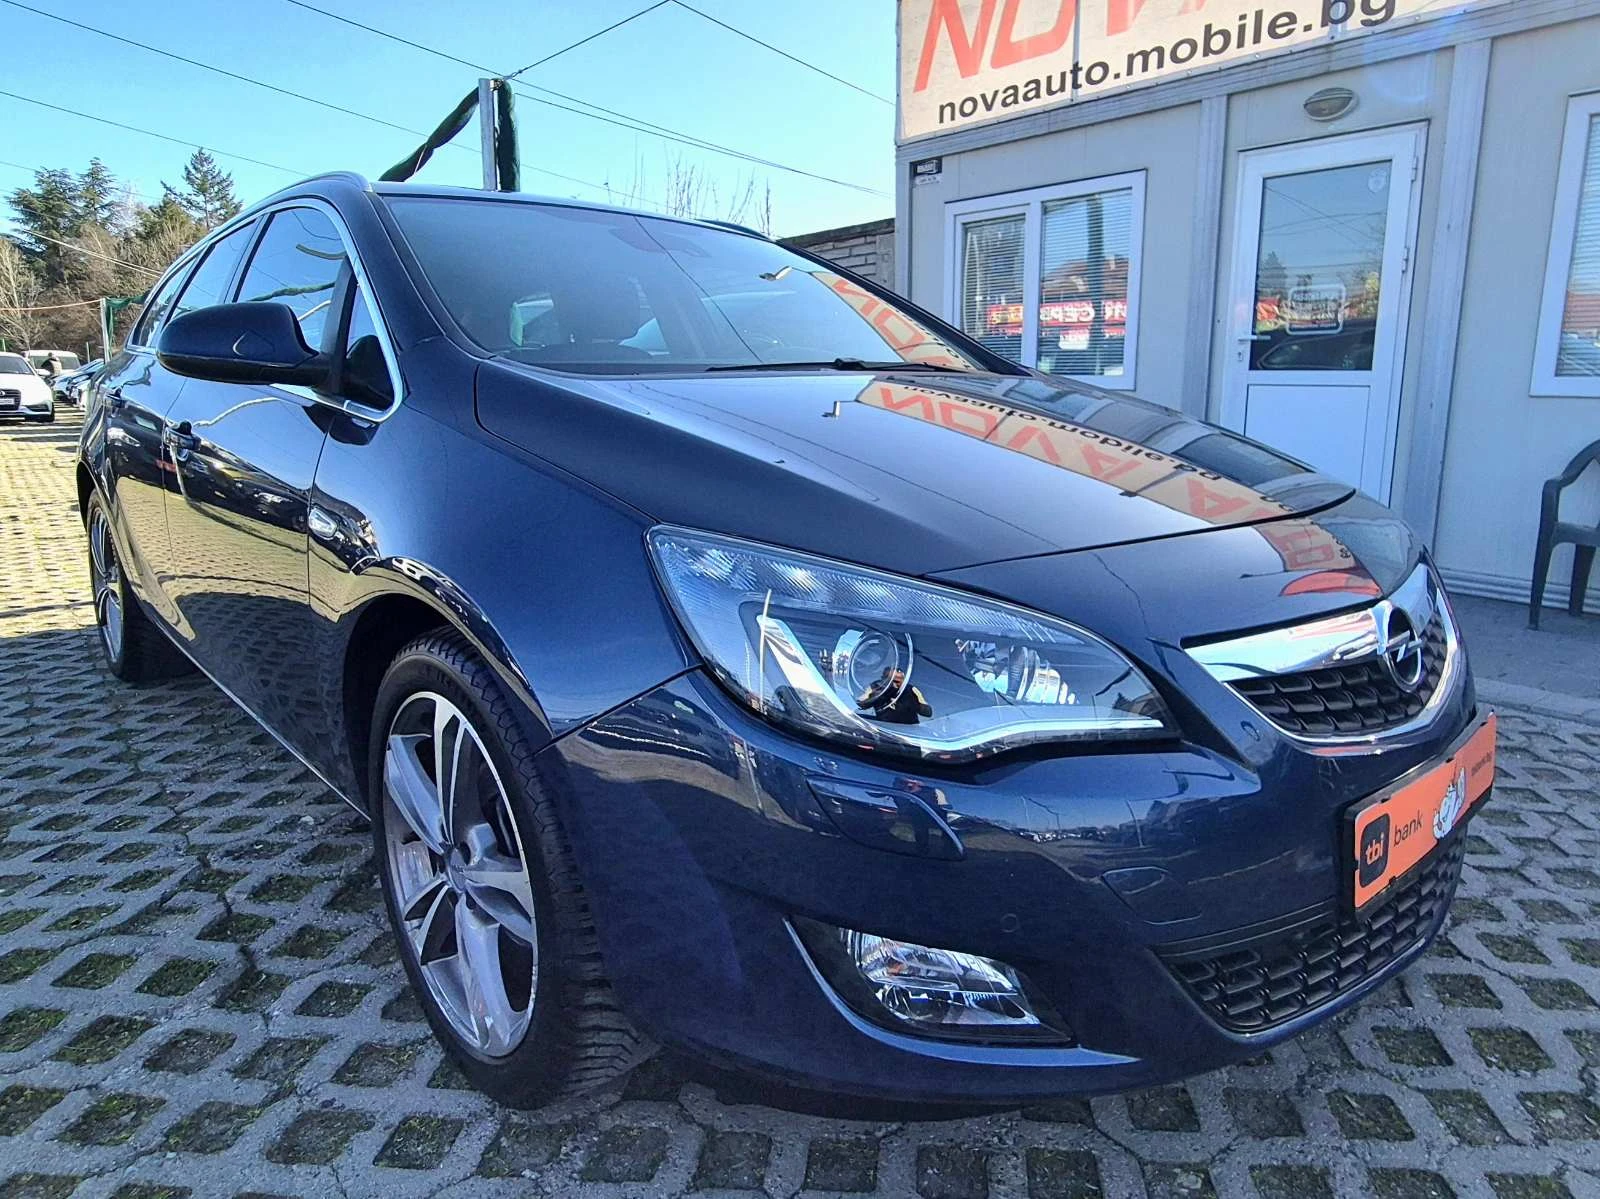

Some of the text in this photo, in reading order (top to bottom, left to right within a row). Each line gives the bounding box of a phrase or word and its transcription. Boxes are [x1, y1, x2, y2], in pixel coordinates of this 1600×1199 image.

[938, 0, 1397, 124] novaauto.mobile.bg
[1365, 809, 1423, 865] tbi bank
